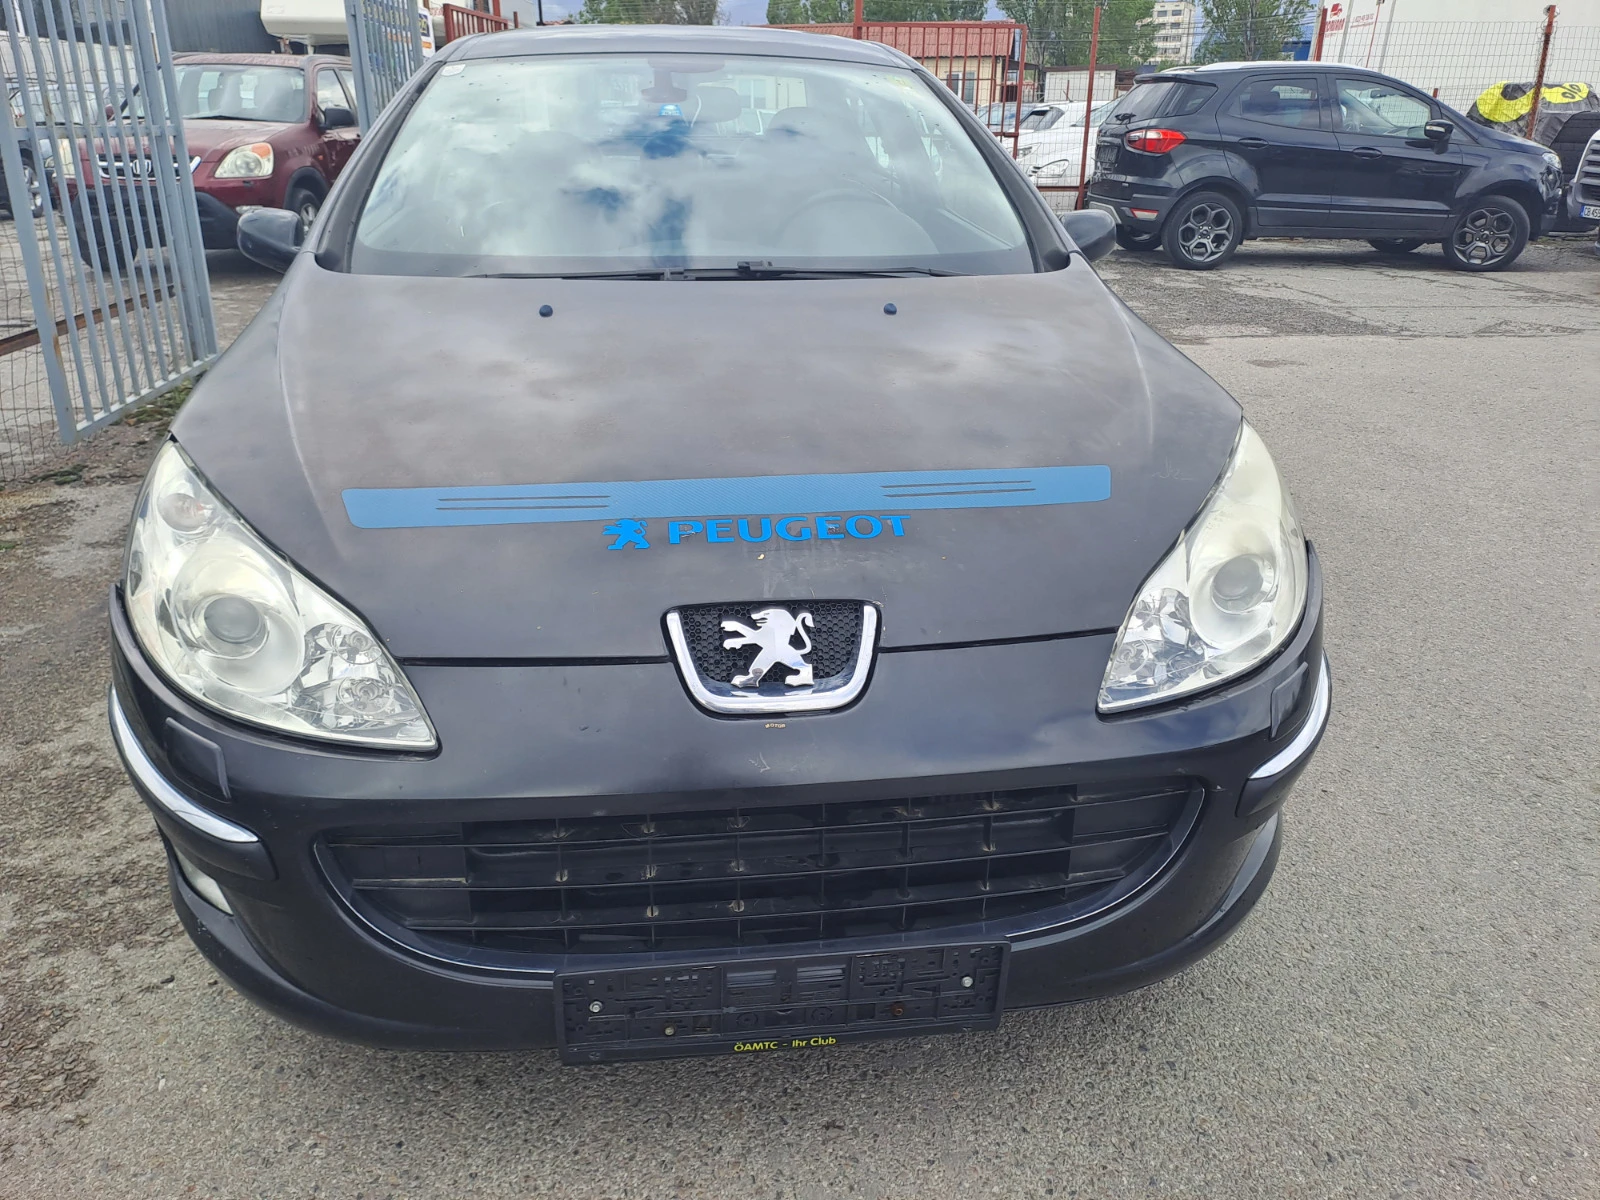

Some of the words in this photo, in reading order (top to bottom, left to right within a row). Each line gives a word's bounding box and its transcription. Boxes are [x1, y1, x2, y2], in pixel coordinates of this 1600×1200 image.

[667, 514, 911, 545] PEUGEOT
[733, 1041, 779, 1052] ÖAMTC
[792, 1039, 808, 1048] Ihr
[810, 1036, 837, 1046] Club
